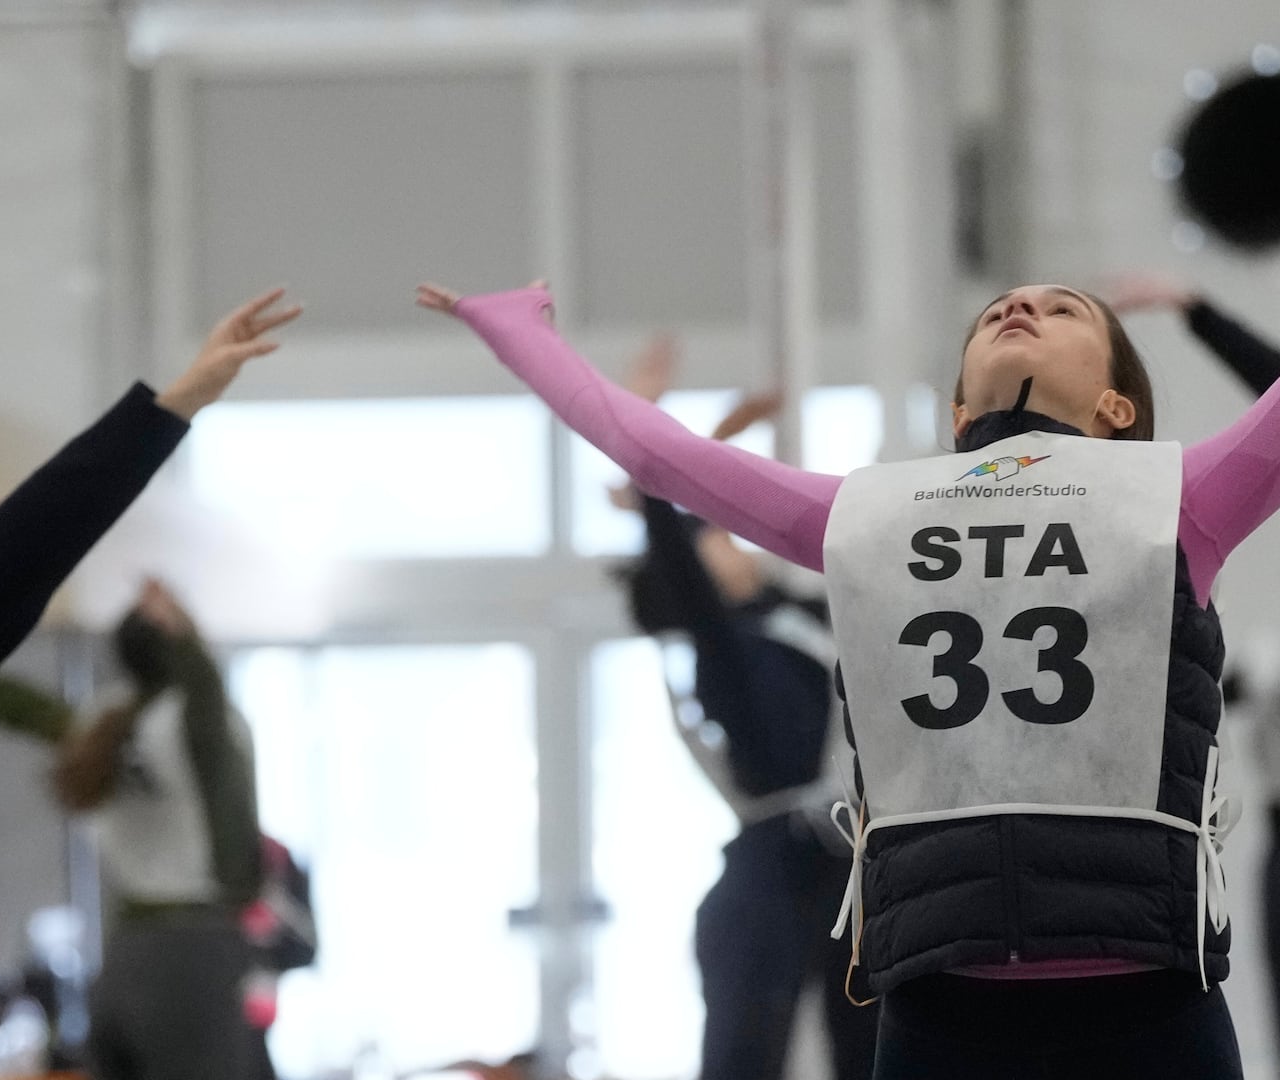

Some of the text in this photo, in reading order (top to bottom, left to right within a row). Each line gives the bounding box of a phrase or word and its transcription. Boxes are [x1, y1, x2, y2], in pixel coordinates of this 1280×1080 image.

[914, 484, 1087, 500] BalichWonderStudio
[907, 522, 1088, 581] STA
[898, 606, 1095, 729] 33
